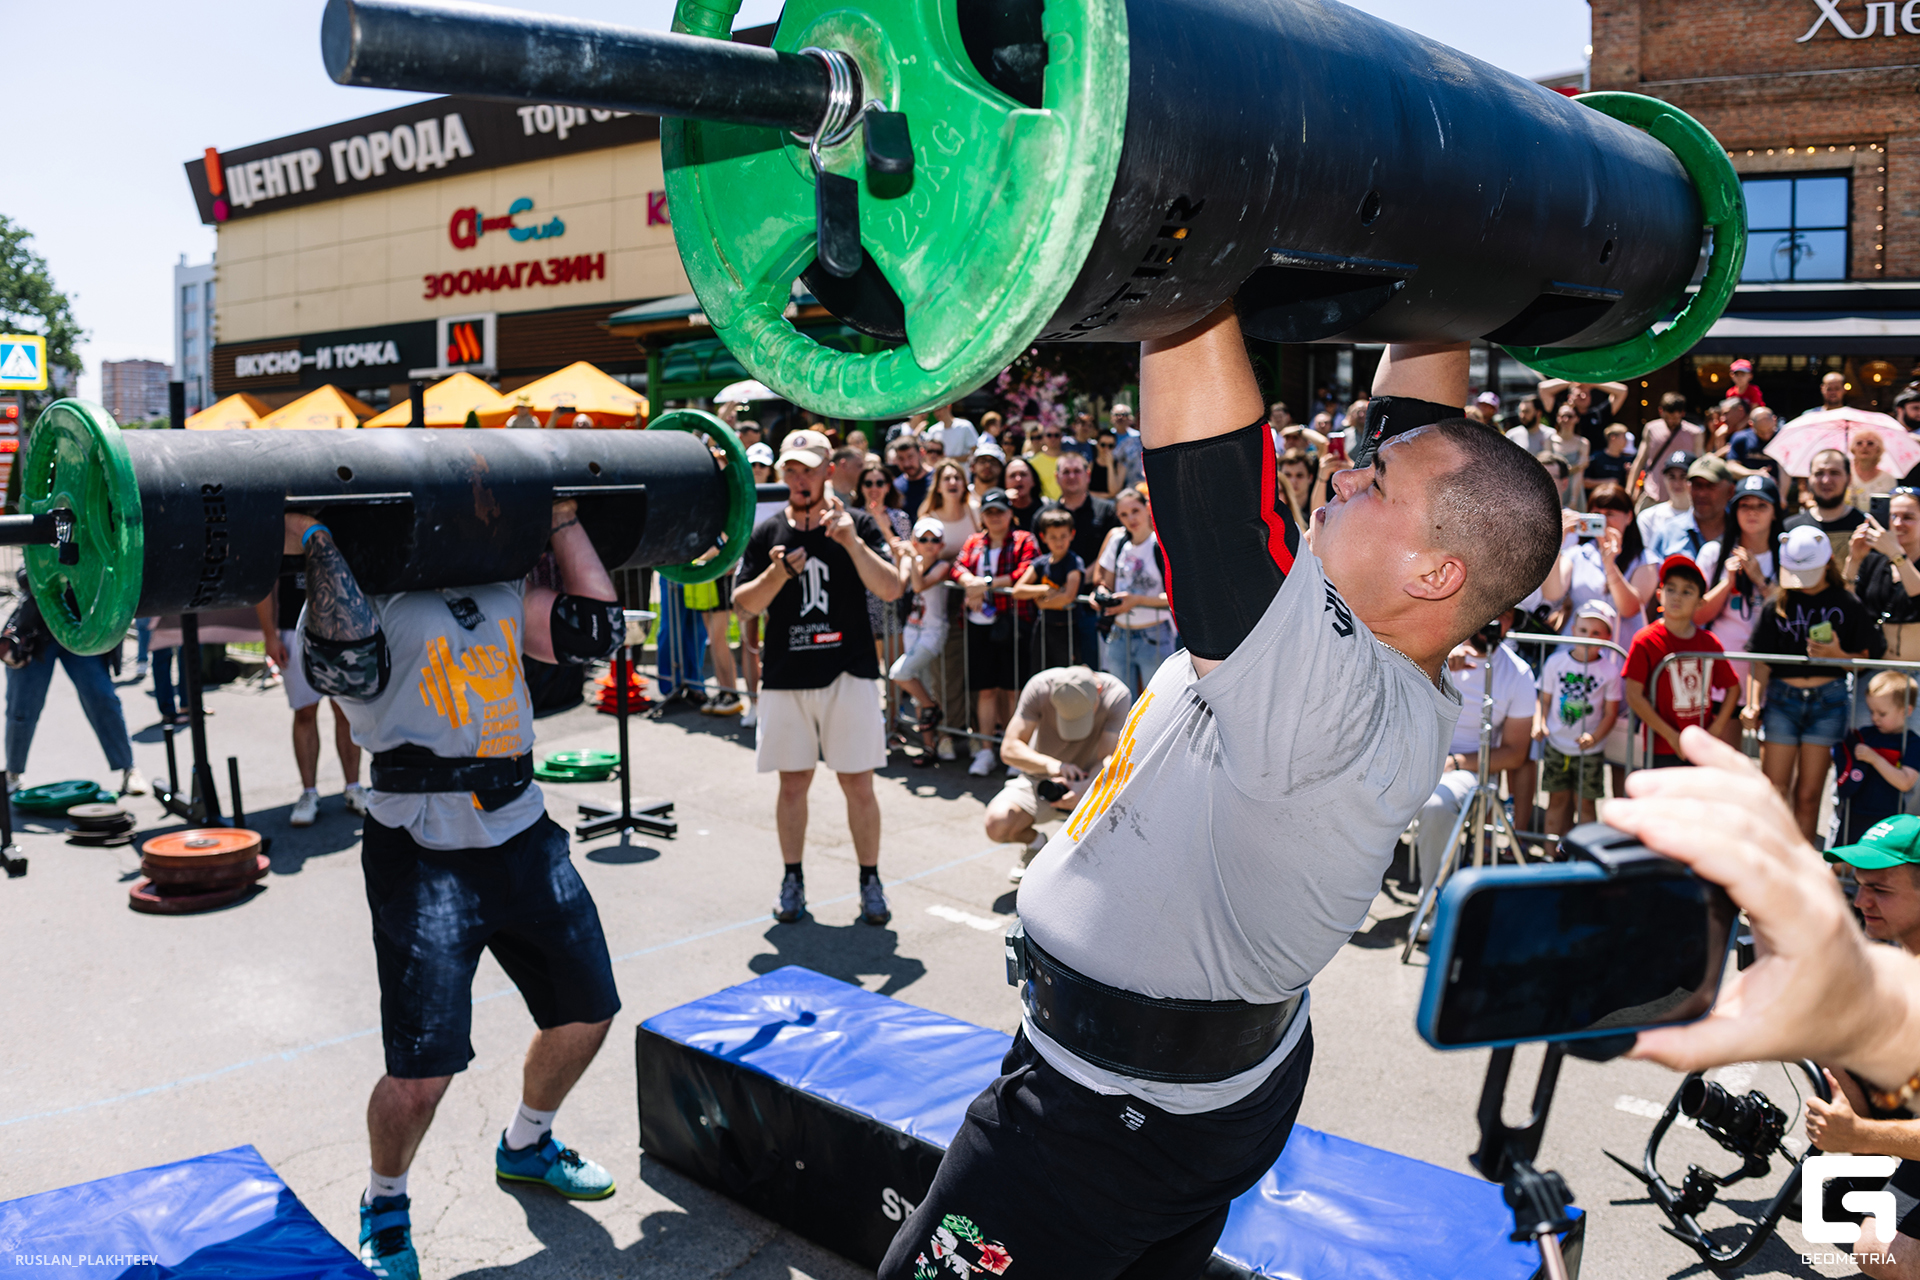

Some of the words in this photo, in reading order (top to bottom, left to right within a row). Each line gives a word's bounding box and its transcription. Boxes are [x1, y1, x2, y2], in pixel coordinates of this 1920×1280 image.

[225, 148, 323, 208] ЦЕНТР
[329, 113, 474, 185] ГОРОДА
[423, 252, 606, 299] ЗООМАГАЗИН
[1033, 193, 1206, 342] ECTER
[332, 340, 400, 369] ТОЧКА
